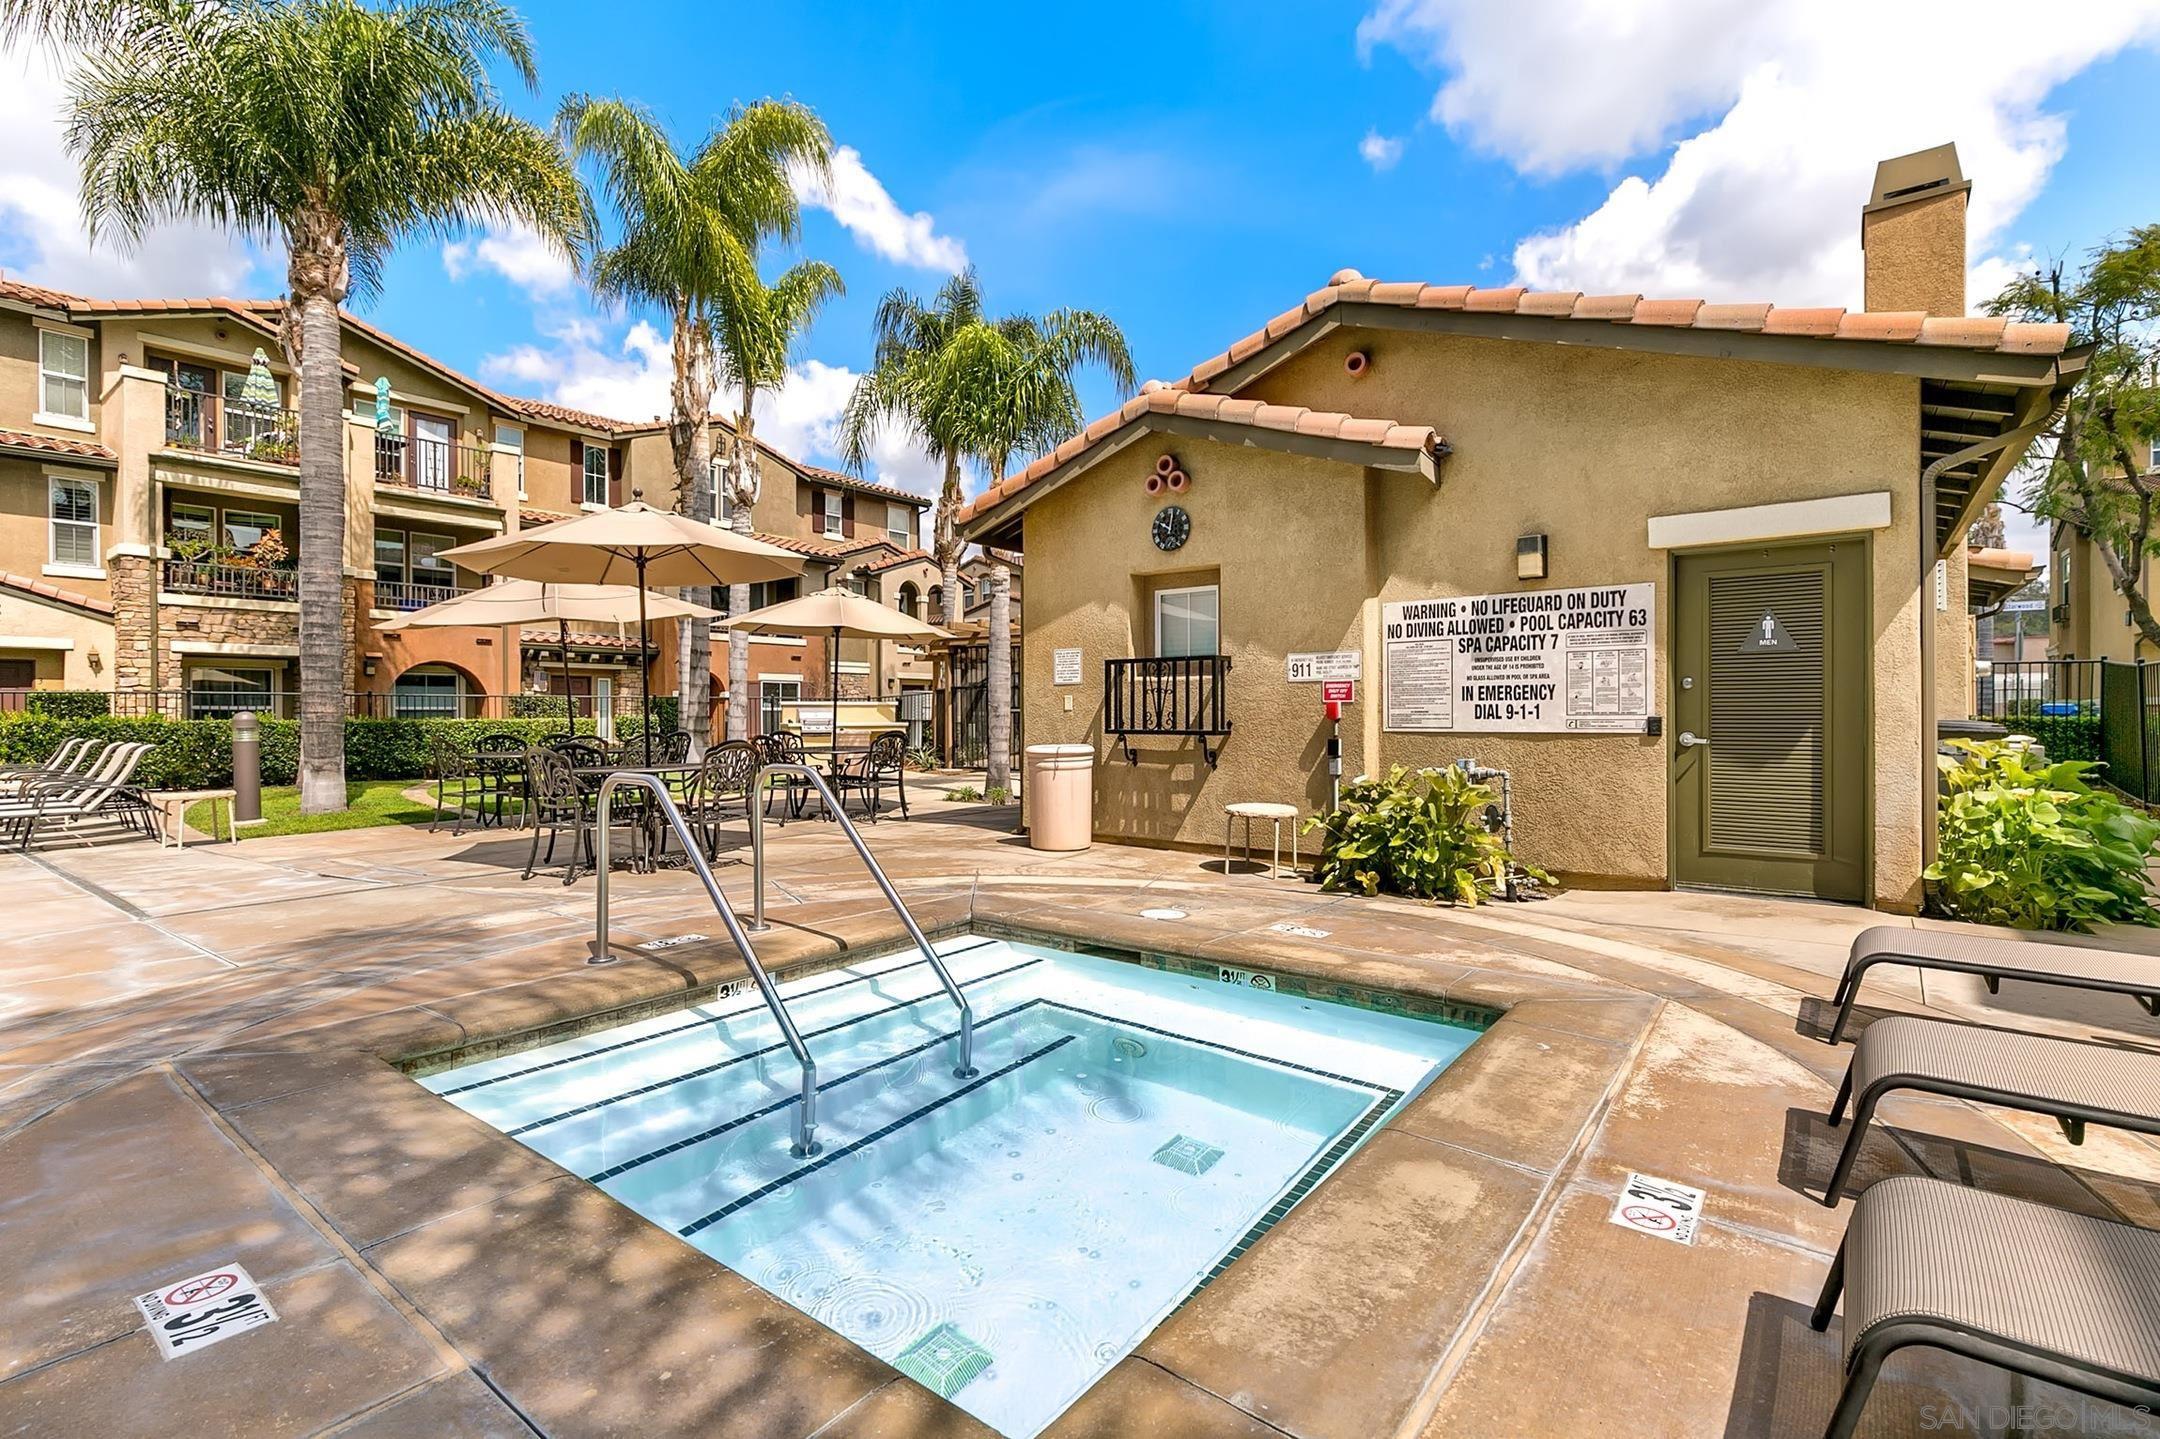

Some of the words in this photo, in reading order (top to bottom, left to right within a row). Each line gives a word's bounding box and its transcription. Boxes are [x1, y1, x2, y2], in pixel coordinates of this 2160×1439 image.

[1402, 602, 1456, 620] WARNING
[1471, 600, 1488, 616] NO
[1492, 594, 1562, 614] LIFEGUARD
[1567, 592, 1586, 610] ON
[1590, 590, 1627, 608] DUTY
[1387, 624, 1402, 639] NO
[1406, 622, 1444, 638] DIVING
[1447, 618, 1504, 636] ALLOWED
[1520, 615, 1554, 632] POOL
[1558, 610, 1624, 630] CAPACITY
[1628, 609, 1647, 626] 63
[1458, 638, 1482, 654] SPA
[1486, 634, 1546, 652] CAPACITY
[1551, 634, 1559, 650] 7
[1292, 663, 1311, 678] 911
[1462, 686, 1474, 701] IN
[1478, 684, 1556, 701] EMERGENCY
[1474, 704, 1502, 720] DIAL
[1506, 704, 1540, 720] 9-1-1
